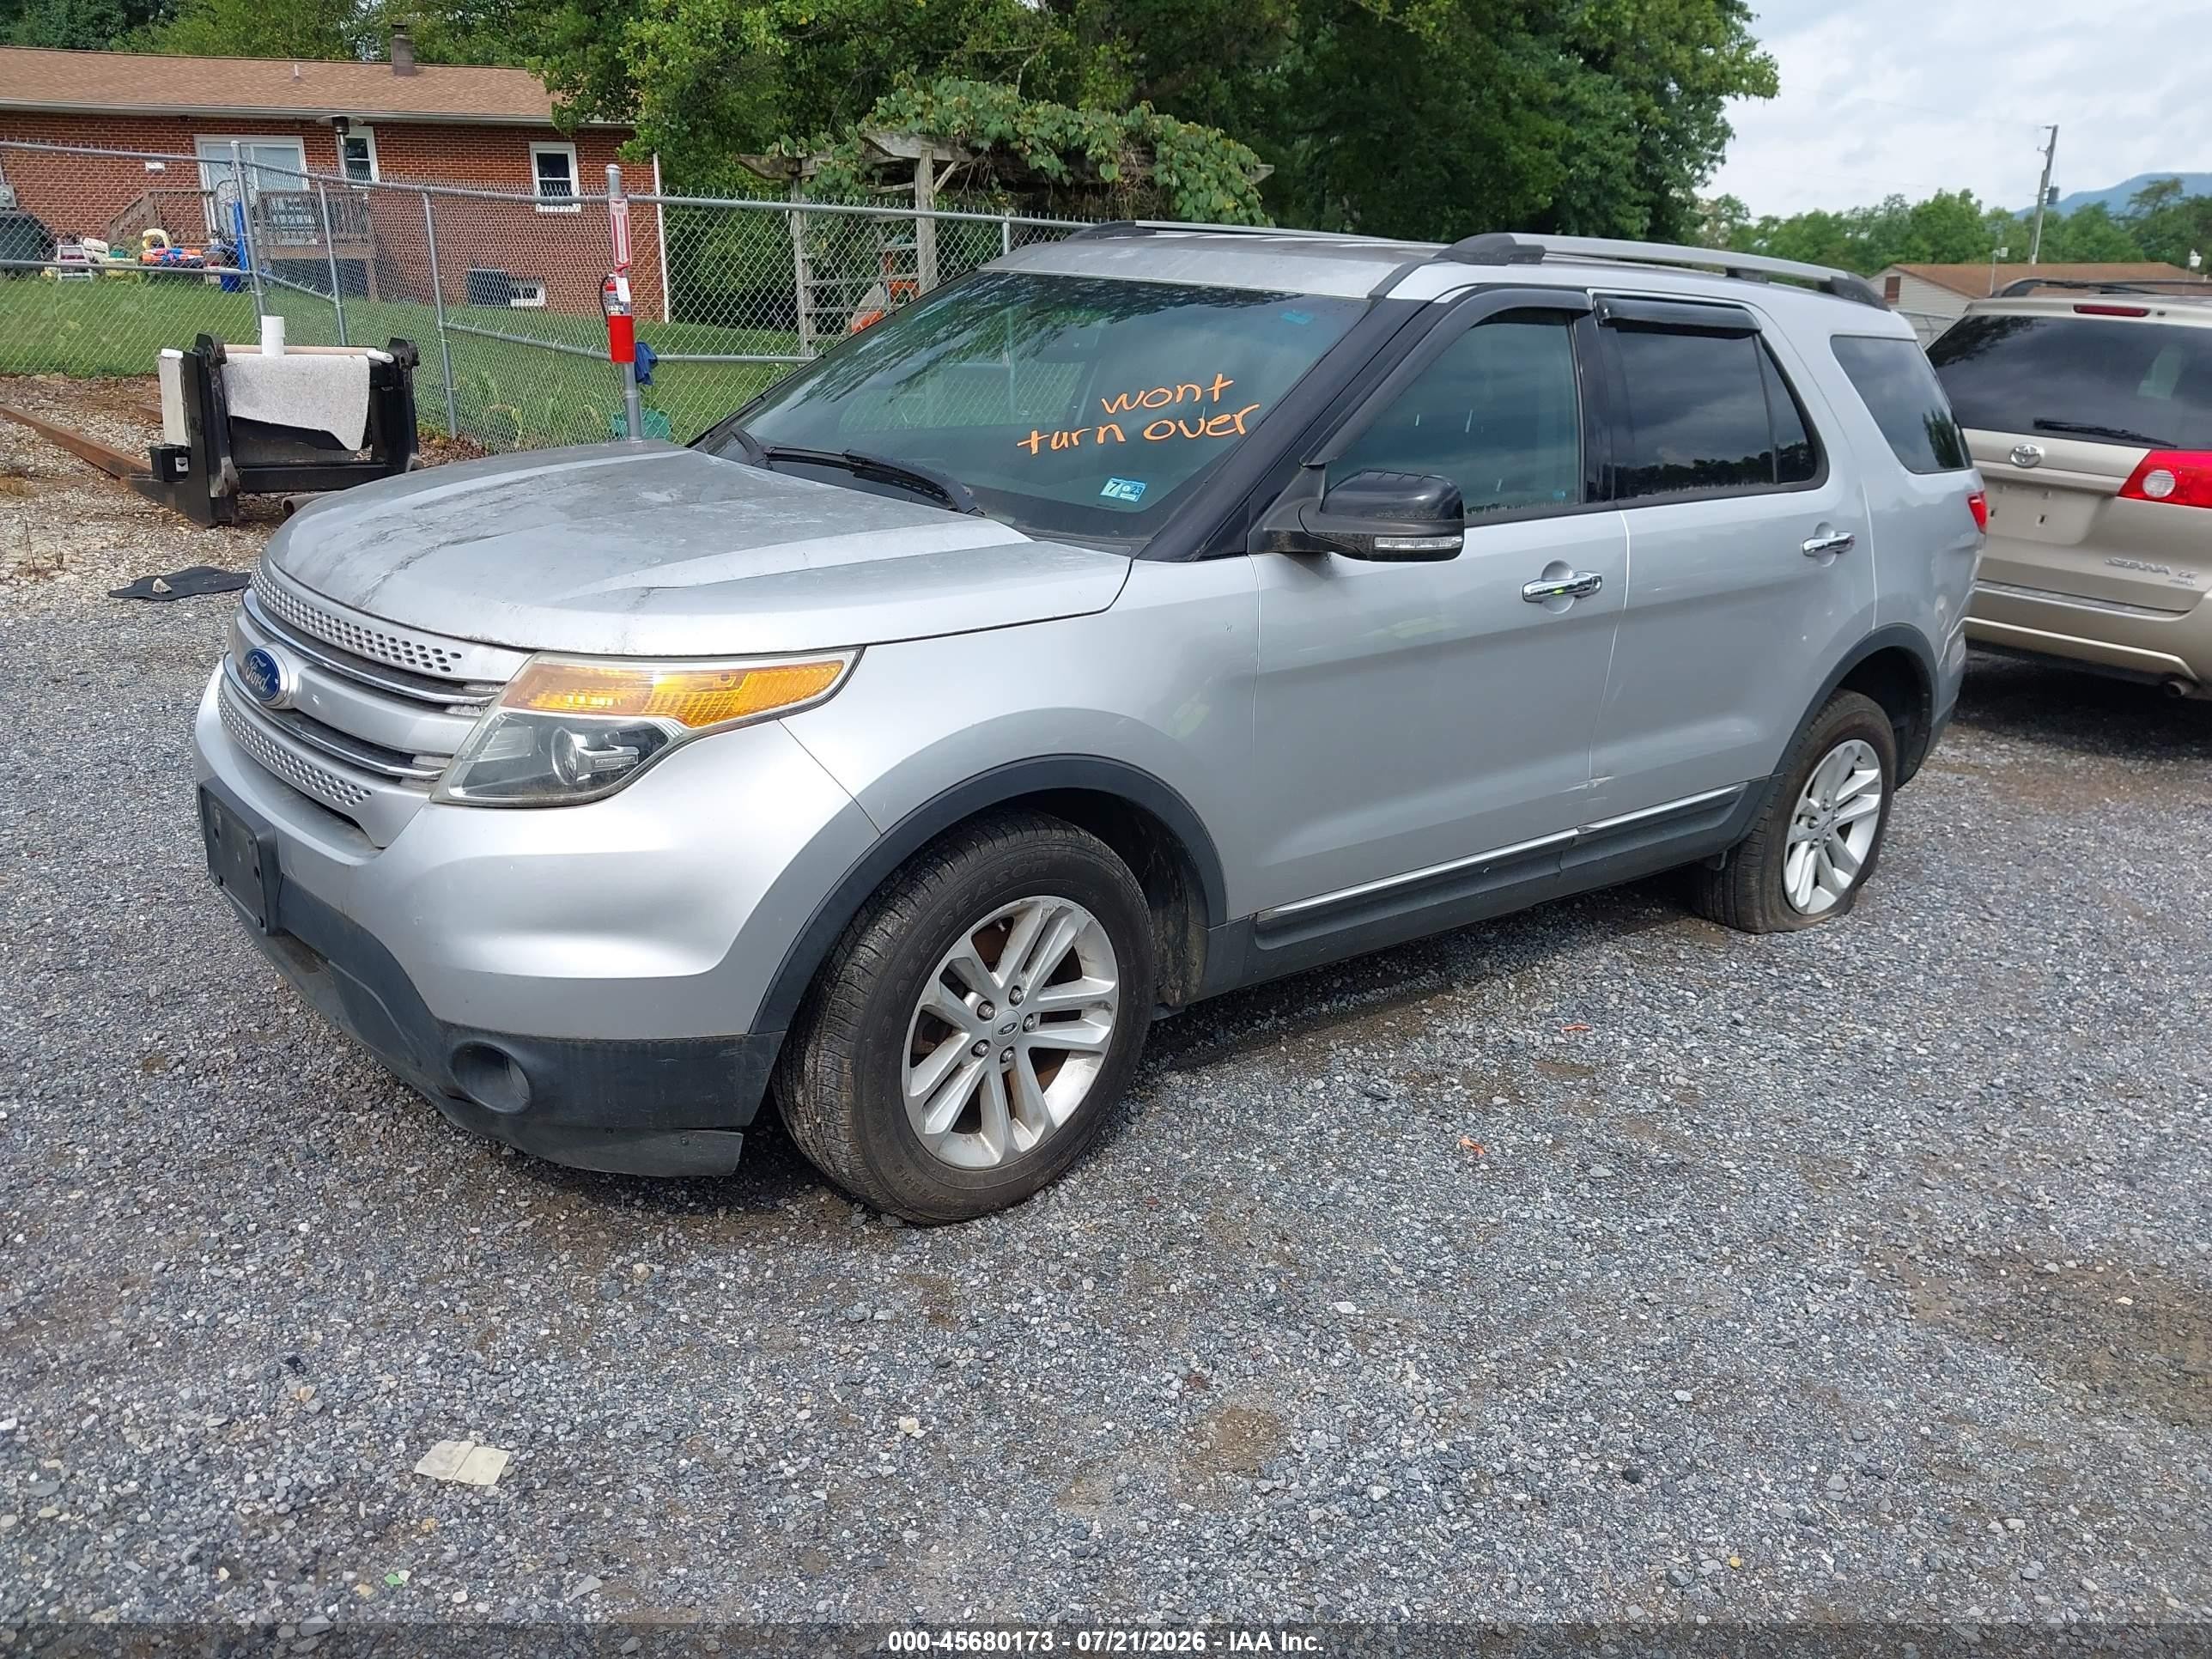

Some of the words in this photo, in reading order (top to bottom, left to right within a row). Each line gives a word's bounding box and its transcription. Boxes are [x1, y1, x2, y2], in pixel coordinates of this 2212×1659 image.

[1101, 373, 1235, 415] wont
[1017, 423, 1127, 455] turn
[1142, 404, 1261, 441] over
[1109, 481, 1121, 493] 7
[246, 654, 271, 692] Ford
